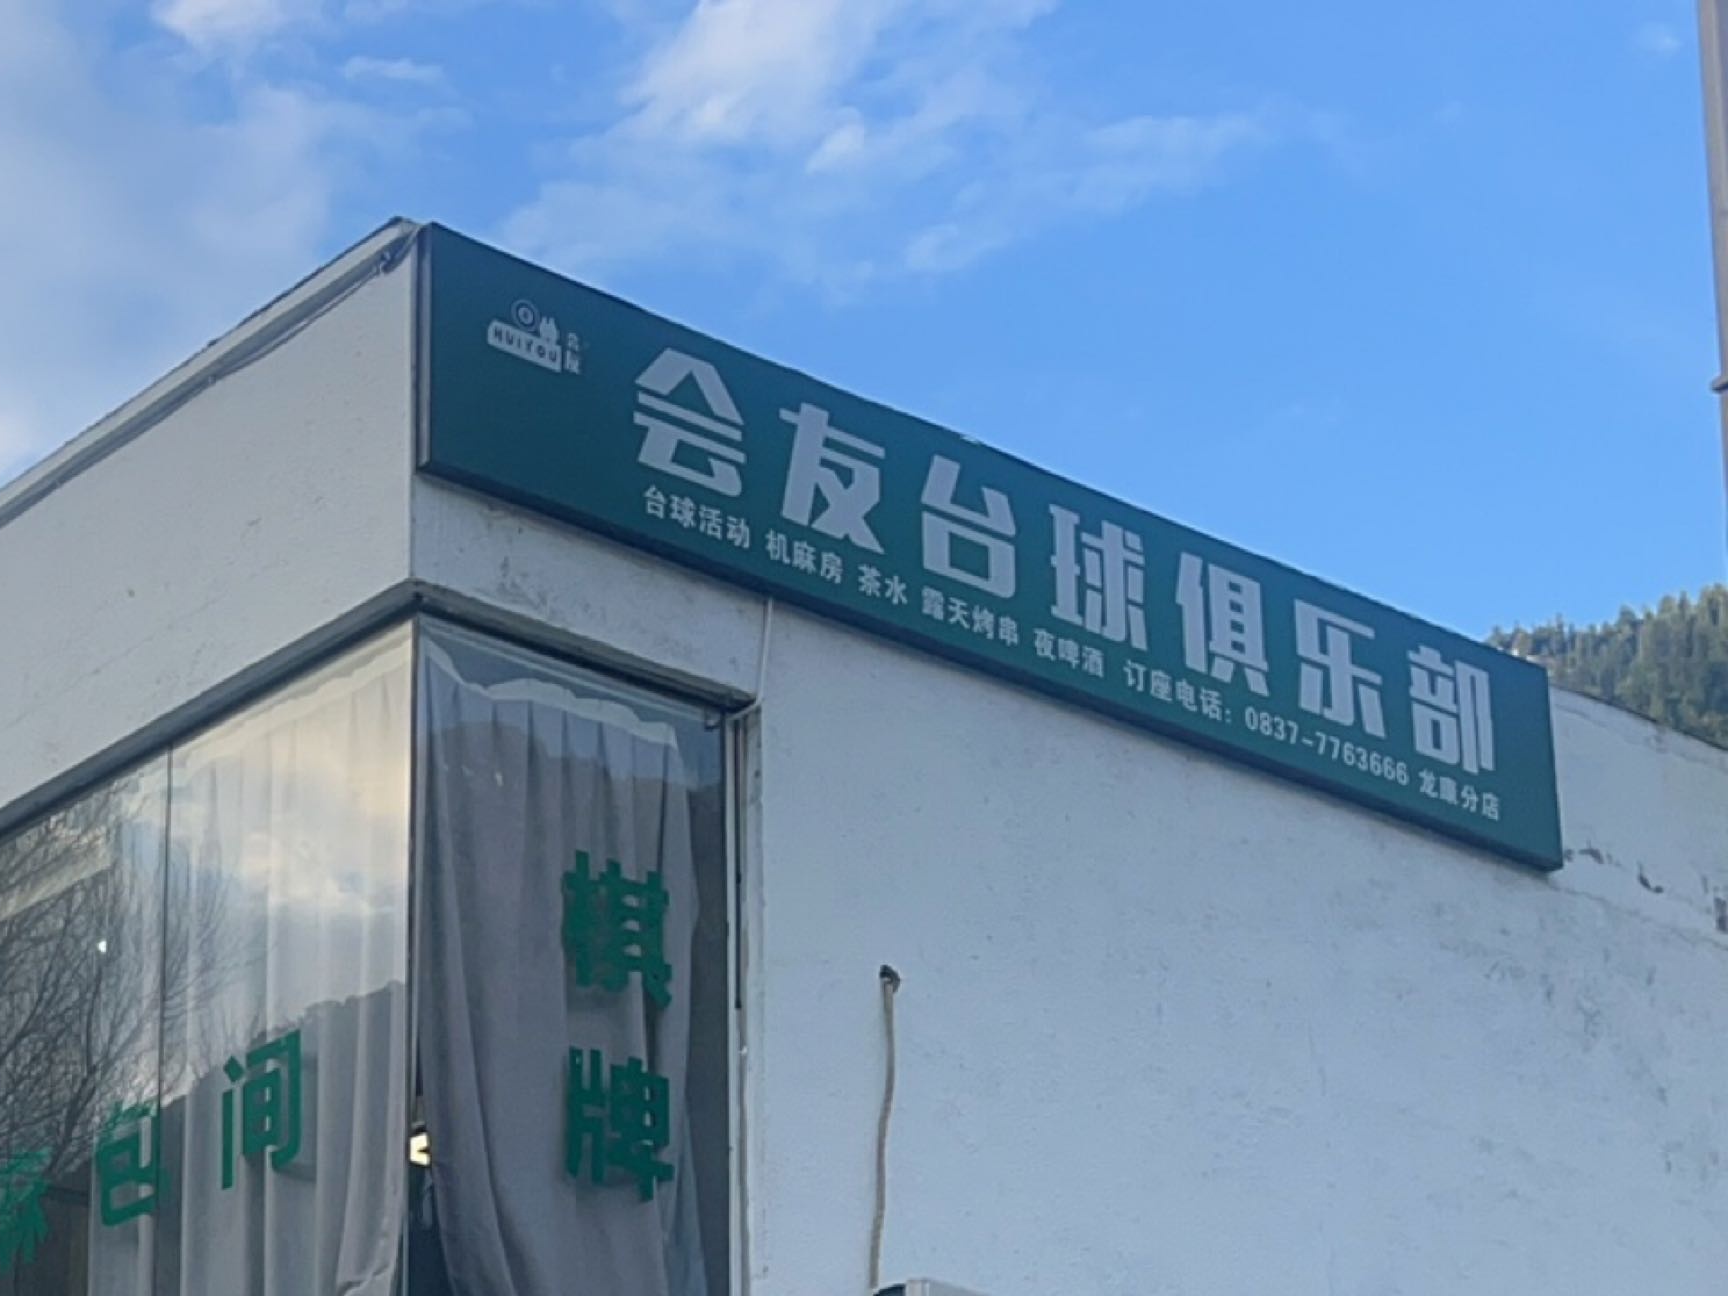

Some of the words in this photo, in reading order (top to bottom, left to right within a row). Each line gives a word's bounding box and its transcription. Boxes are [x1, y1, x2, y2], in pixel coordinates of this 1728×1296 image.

[633, 347, 1496, 775] 会友台球俱乐部
[643, 485, 750, 548] 台球活动
[765, 530, 843, 584] 机麻房
[858, 564, 908, 604] 茶水
[922, 586, 1019, 646] 露天烤串
[1033, 628, 1104, 677] 夜啤酒
[562, 850, 674, 1202] 棋牌
